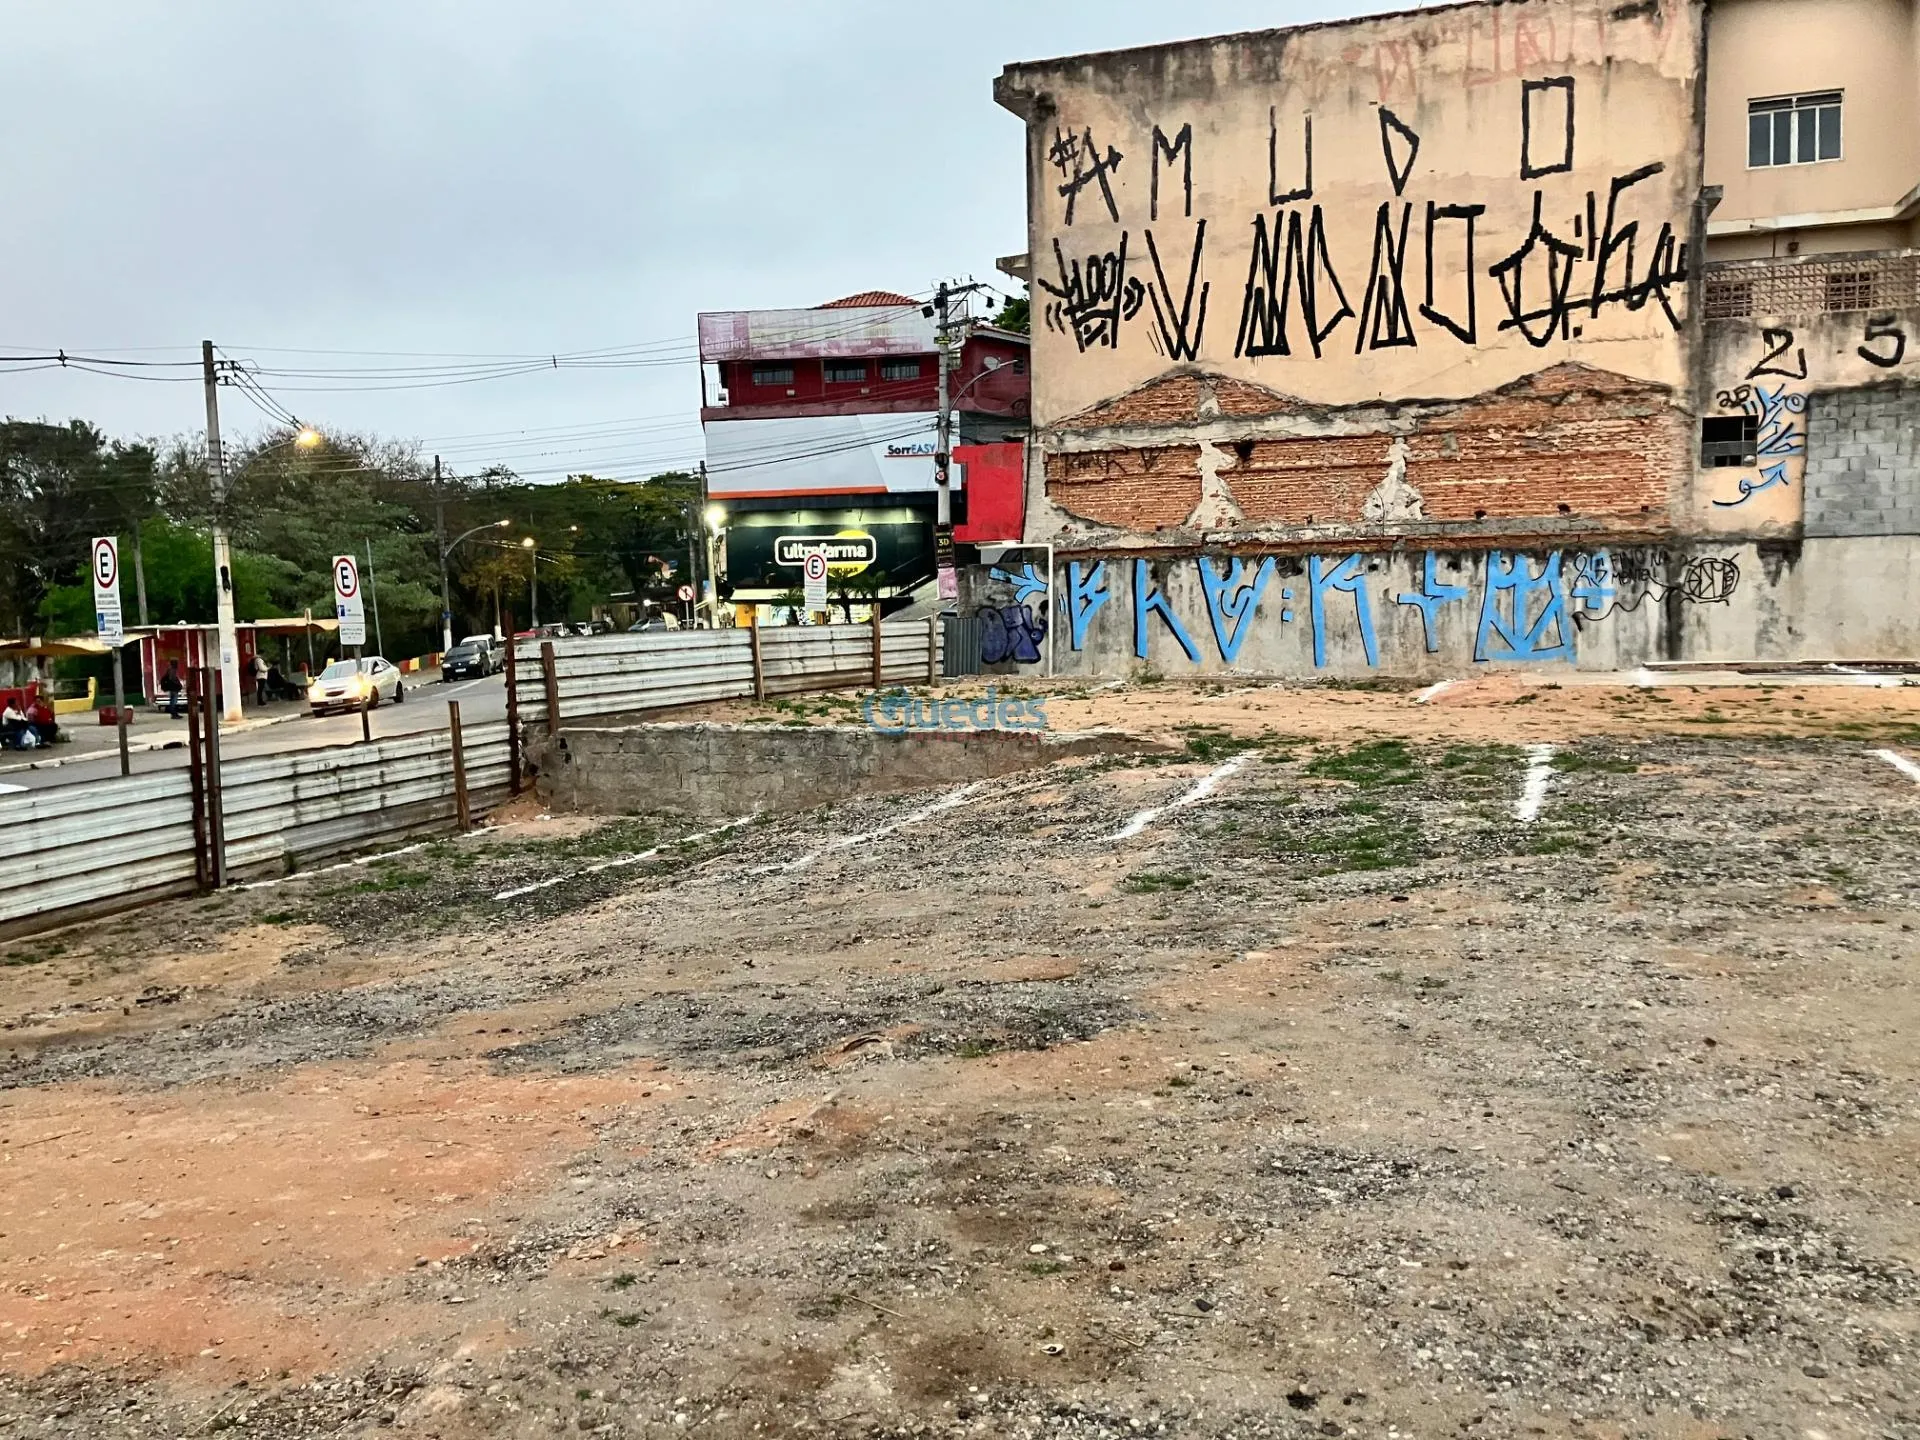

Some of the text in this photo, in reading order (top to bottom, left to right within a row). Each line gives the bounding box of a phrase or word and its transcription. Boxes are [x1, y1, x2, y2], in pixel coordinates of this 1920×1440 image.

[99, 552, 110, 578] E
[811, 559, 819, 575] E
[340, 566, 351, 589] E
